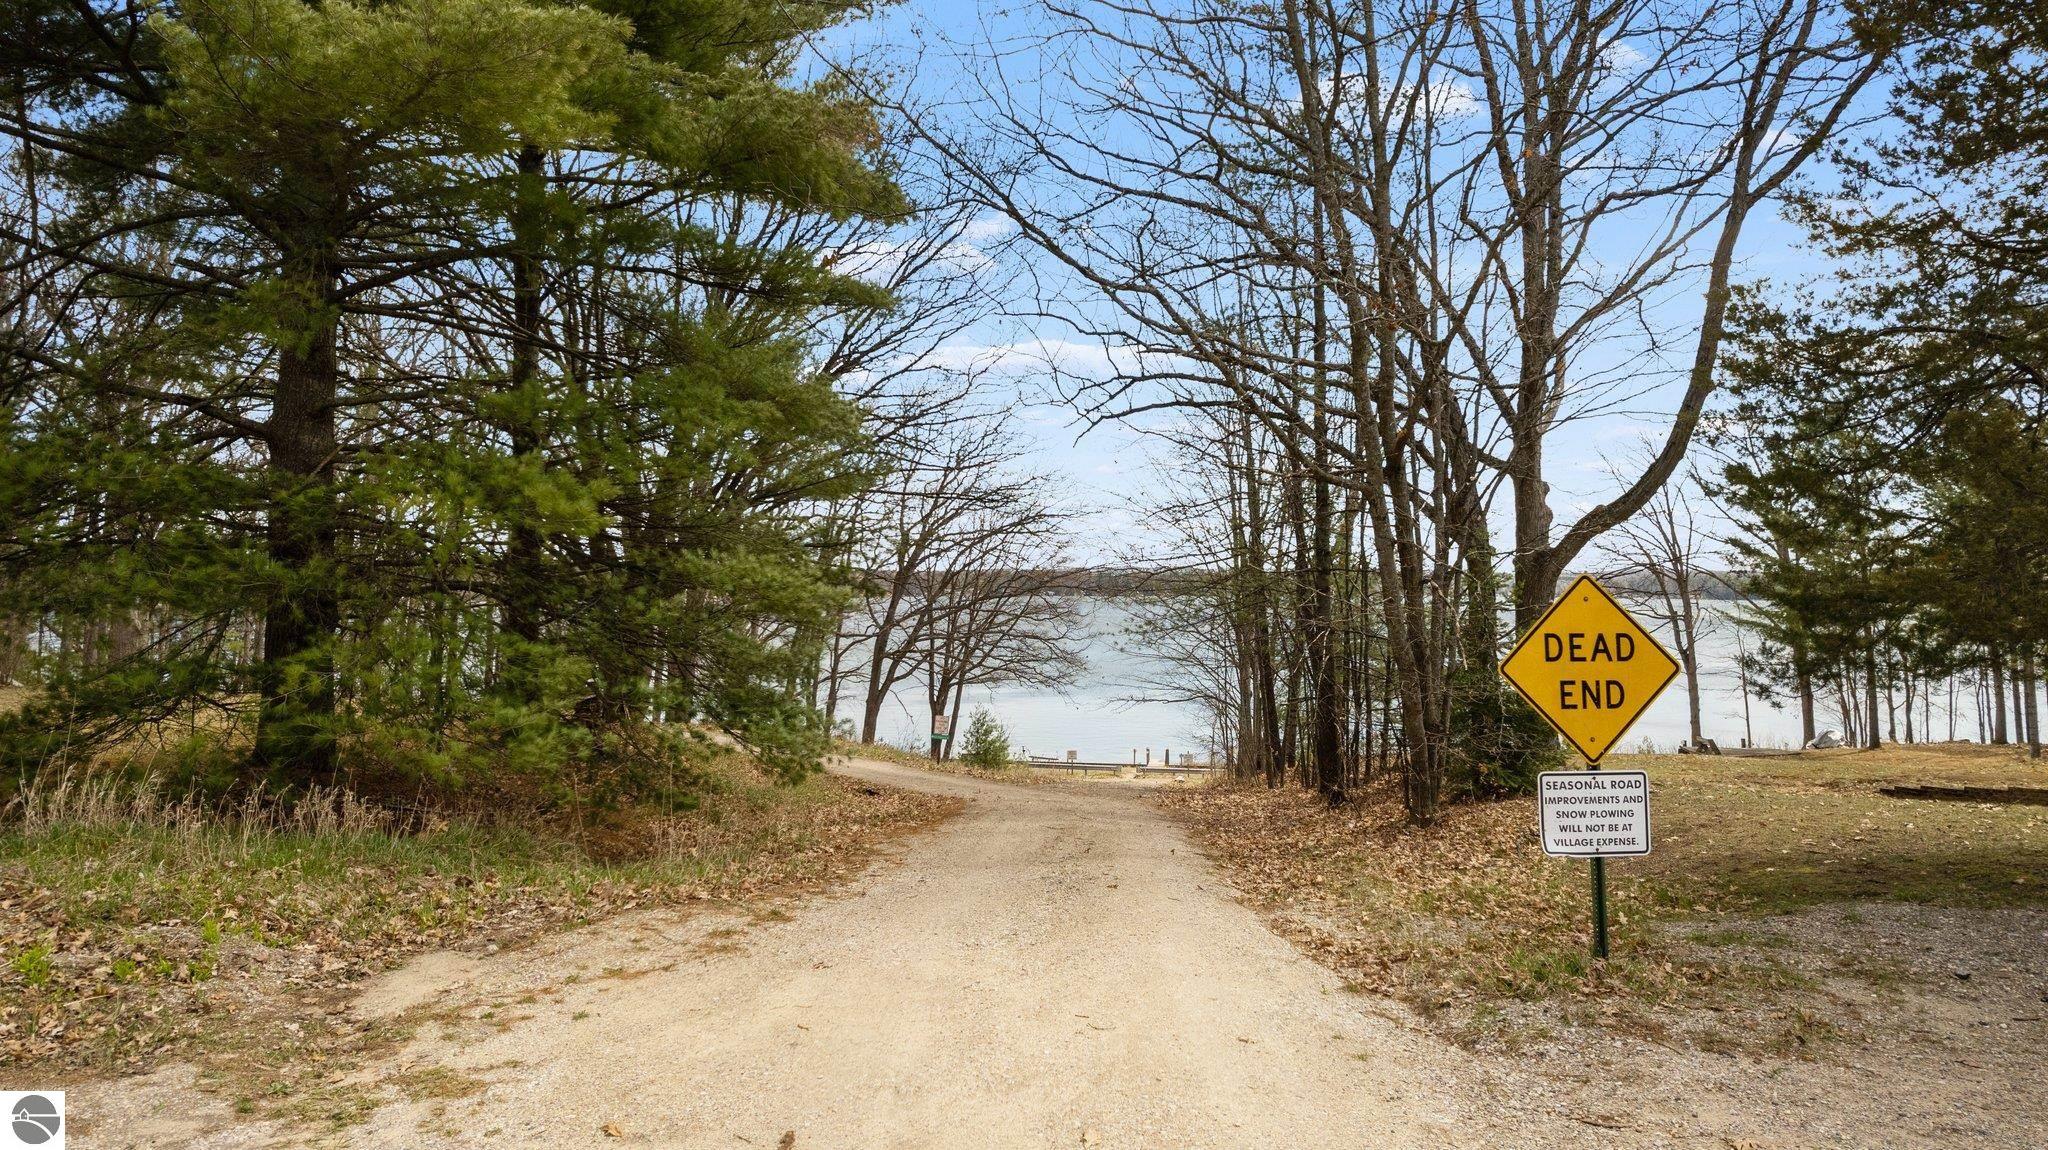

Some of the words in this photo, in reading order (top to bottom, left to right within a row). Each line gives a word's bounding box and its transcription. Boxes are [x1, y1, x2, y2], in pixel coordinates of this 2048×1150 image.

[1544, 633, 1635, 662] DEAD
[1560, 680, 1625, 709] END
[1545, 780, 1607, 790] SEASONAL
[1610, 780, 1642, 789] ROAD
[1544, 796, 1620, 804] IMPROVEMENTS
[1622, 795, 1643, 803] AND
[1556, 810, 1587, 818] SNOW
[1590, 810, 1635, 818] PLOWING
[1585, 824, 1605, 832] NOT
[1553, 838, 1594, 846] VILLAGE
[1596, 837, 1639, 846] EXPENSE.
